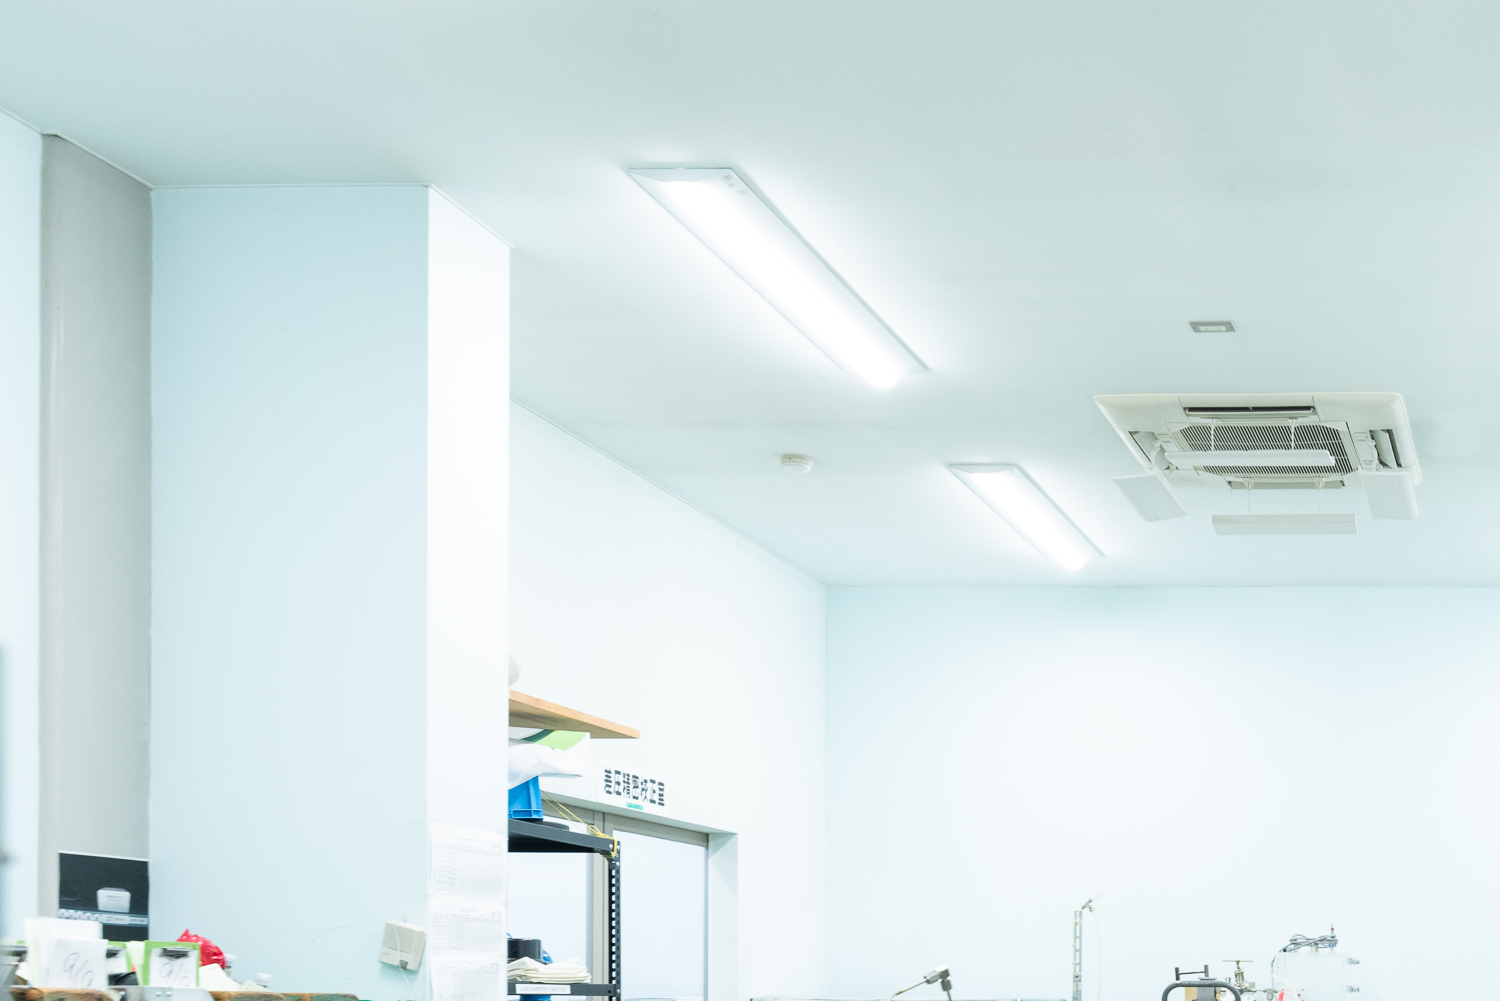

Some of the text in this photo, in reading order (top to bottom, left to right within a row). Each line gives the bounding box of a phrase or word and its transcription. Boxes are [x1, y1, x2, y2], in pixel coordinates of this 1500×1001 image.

[603, 766, 665, 807] 差圧精密校正室
